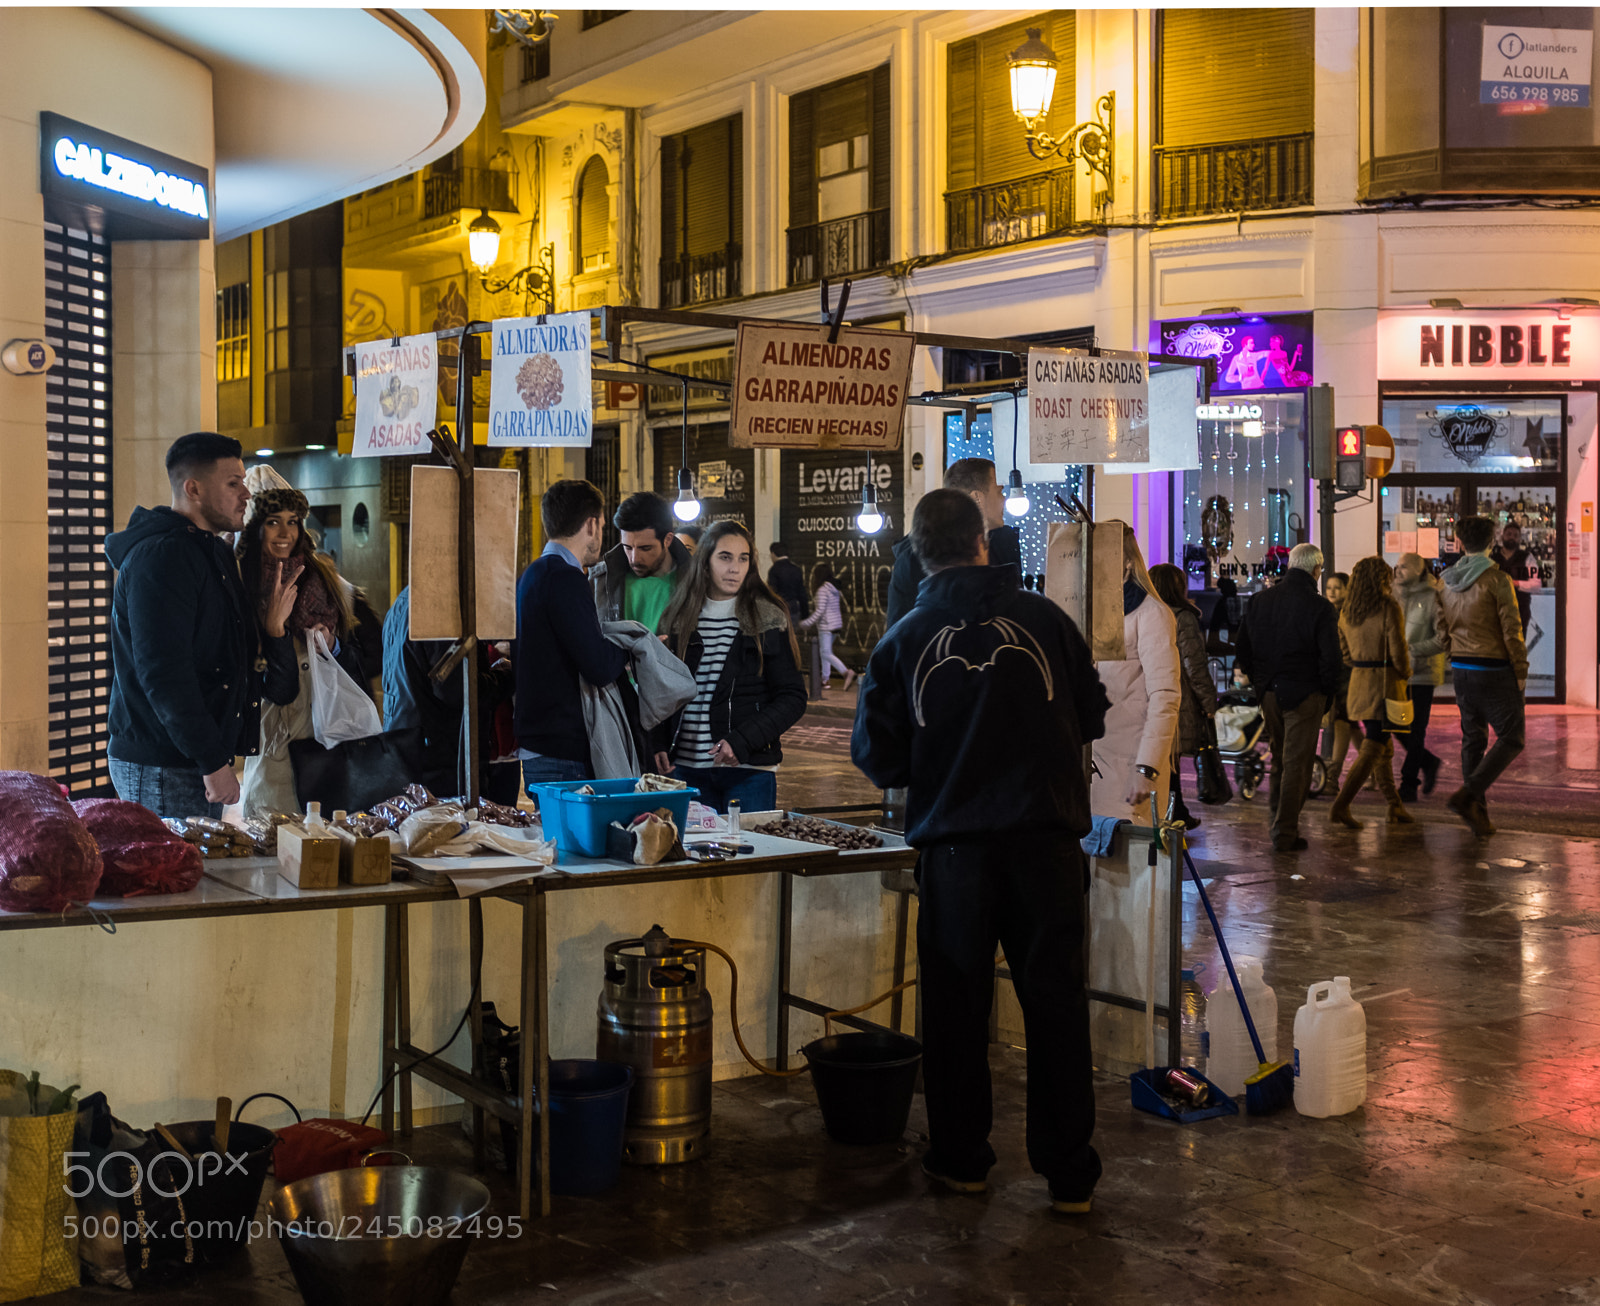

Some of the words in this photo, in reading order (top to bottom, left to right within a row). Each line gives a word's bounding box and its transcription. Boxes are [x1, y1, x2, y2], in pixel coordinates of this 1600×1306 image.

[1503, 65, 1569, 80] ALQUILA
[1491, 86, 1518, 99] 656
[1522, 87, 1549, 101] 998
[1553, 88, 1579, 102] 985
[497, 324, 587, 356] ALMENDRAS
[1420, 324, 1571, 367] NIBBLE
[361, 343, 431, 375] CASTAÑAS
[762, 341, 891, 371] ALMENDRAS
[1099, 362, 1143, 384] ASADAS
[745, 375, 899, 407] GARRAPIÑADAS
[1035, 398, 1073, 418] ROAST
[1081, 398, 1143, 418] CHESTNUTS
[368, 422, 422, 449] ASADAS
[749, 417, 814, 436] (RECIEN
[817, 419, 888, 439] HECHAS)
[799, 458, 892, 493] Levante
[798, 516, 844, 532] QUIOSCO
[816, 535, 880, 557] ESPAÑA
[1219, 563, 1238, 576] GIN
[1252, 563, 1288, 577] TAPAS
